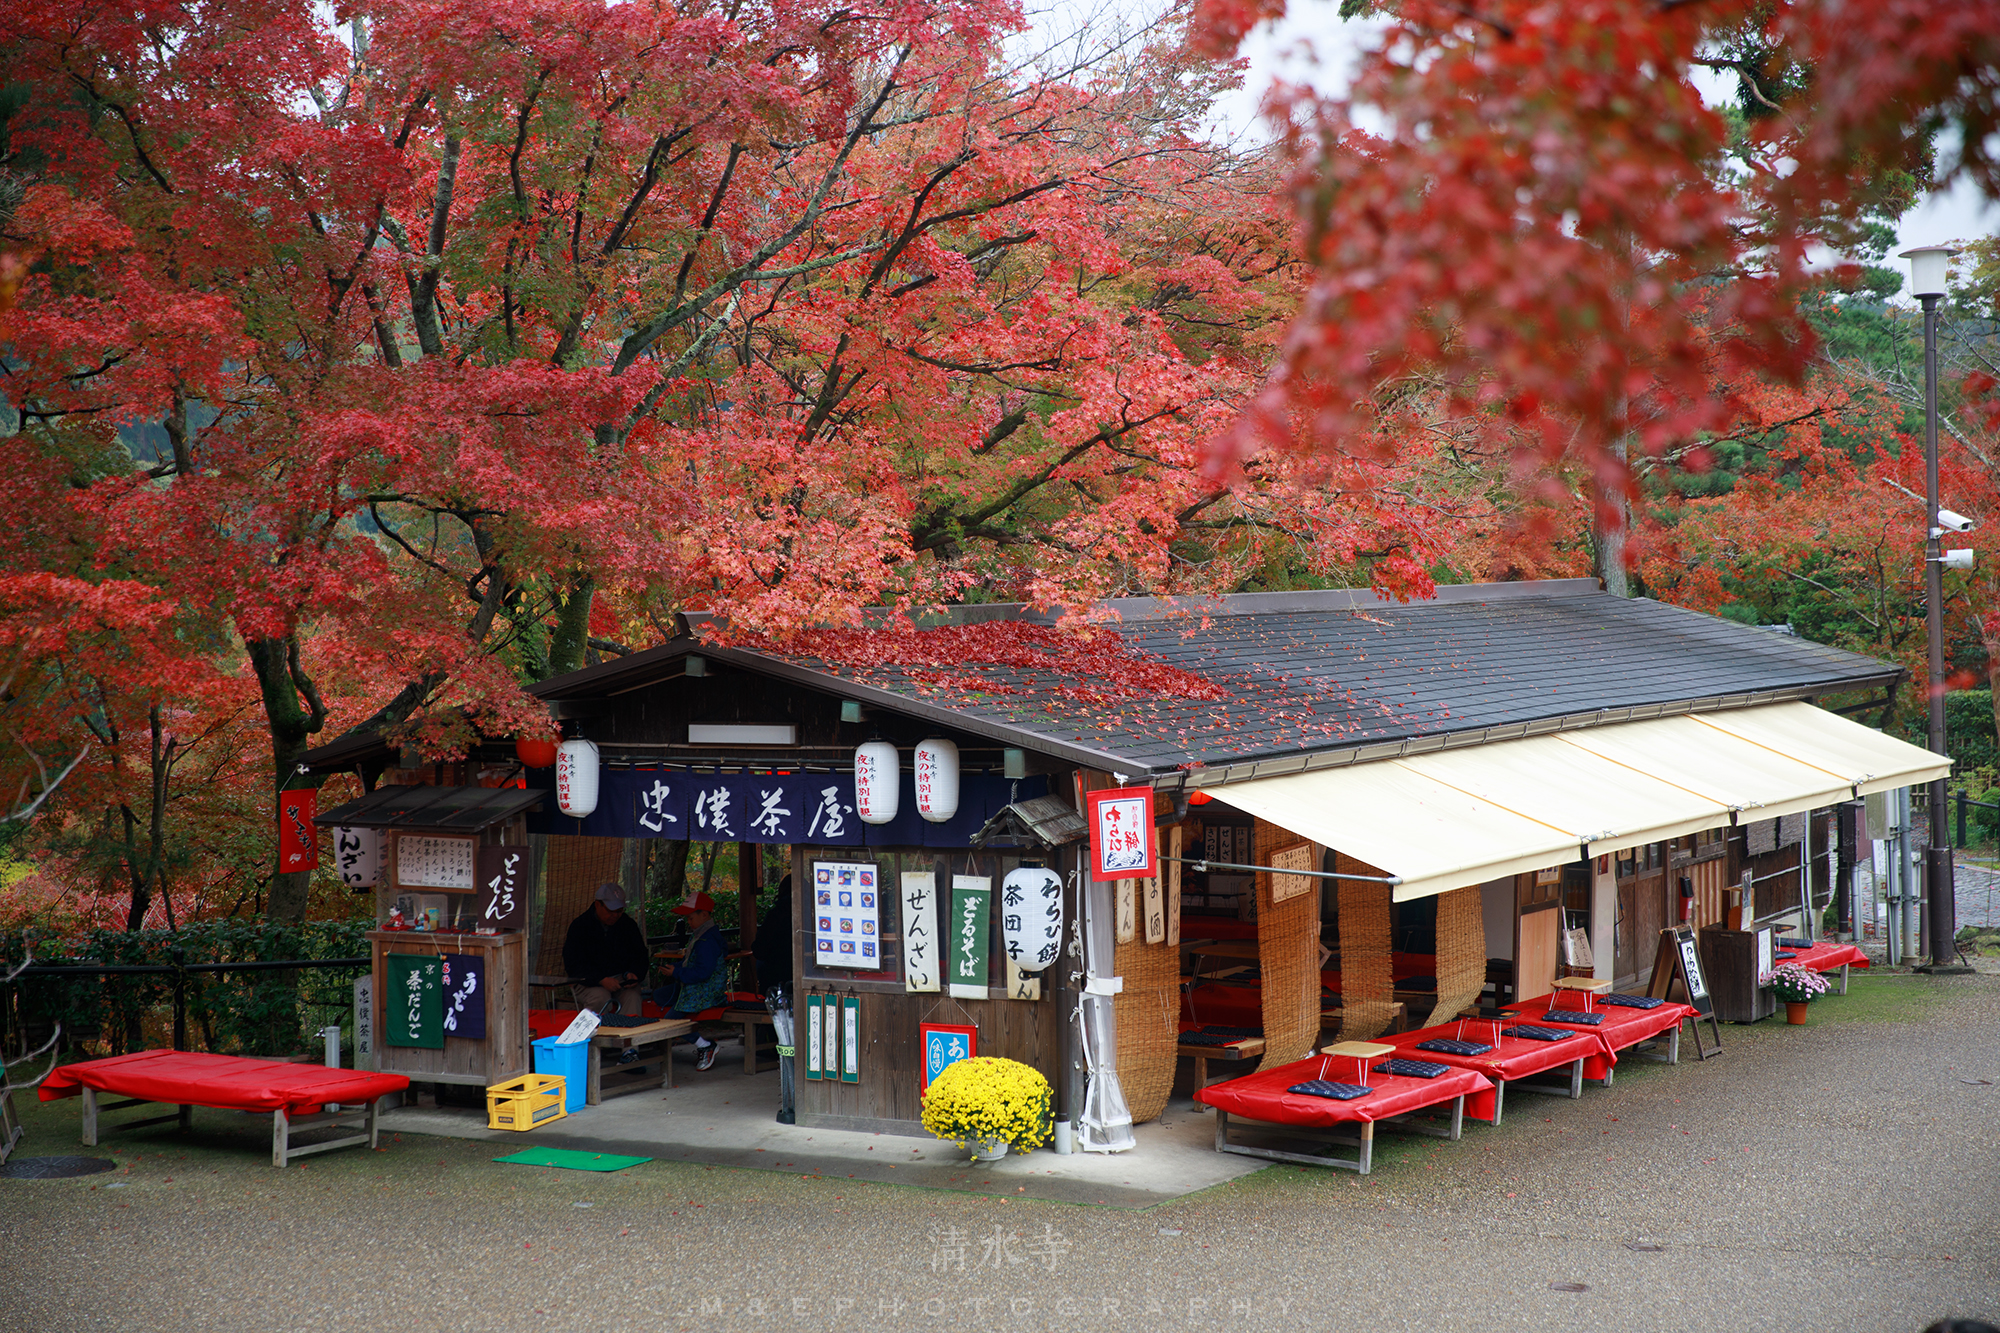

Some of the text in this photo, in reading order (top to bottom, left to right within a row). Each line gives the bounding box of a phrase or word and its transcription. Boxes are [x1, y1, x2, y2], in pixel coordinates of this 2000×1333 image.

[567, 754, 576, 779] 清水寺
[868, 757, 877, 782] 清水寺
[929, 753, 938, 780] 清水寺
[639, 779, 853, 838] 忠僕茶屋
[339, 827, 366, 884] んざい
[906, 888, 931, 990] ぜんざい
[959, 896, 983, 978] ざるそば
[1003, 884, 1025, 961] 茶団子
[1036, 877, 1062, 964] わらび餅
[406, 969, 423, 1040] 茶だんご
[424, 963, 436, 990] 京の
[443, 971, 478, 1032] うどん
[931, 1043, 942, 1069] 味自慢
